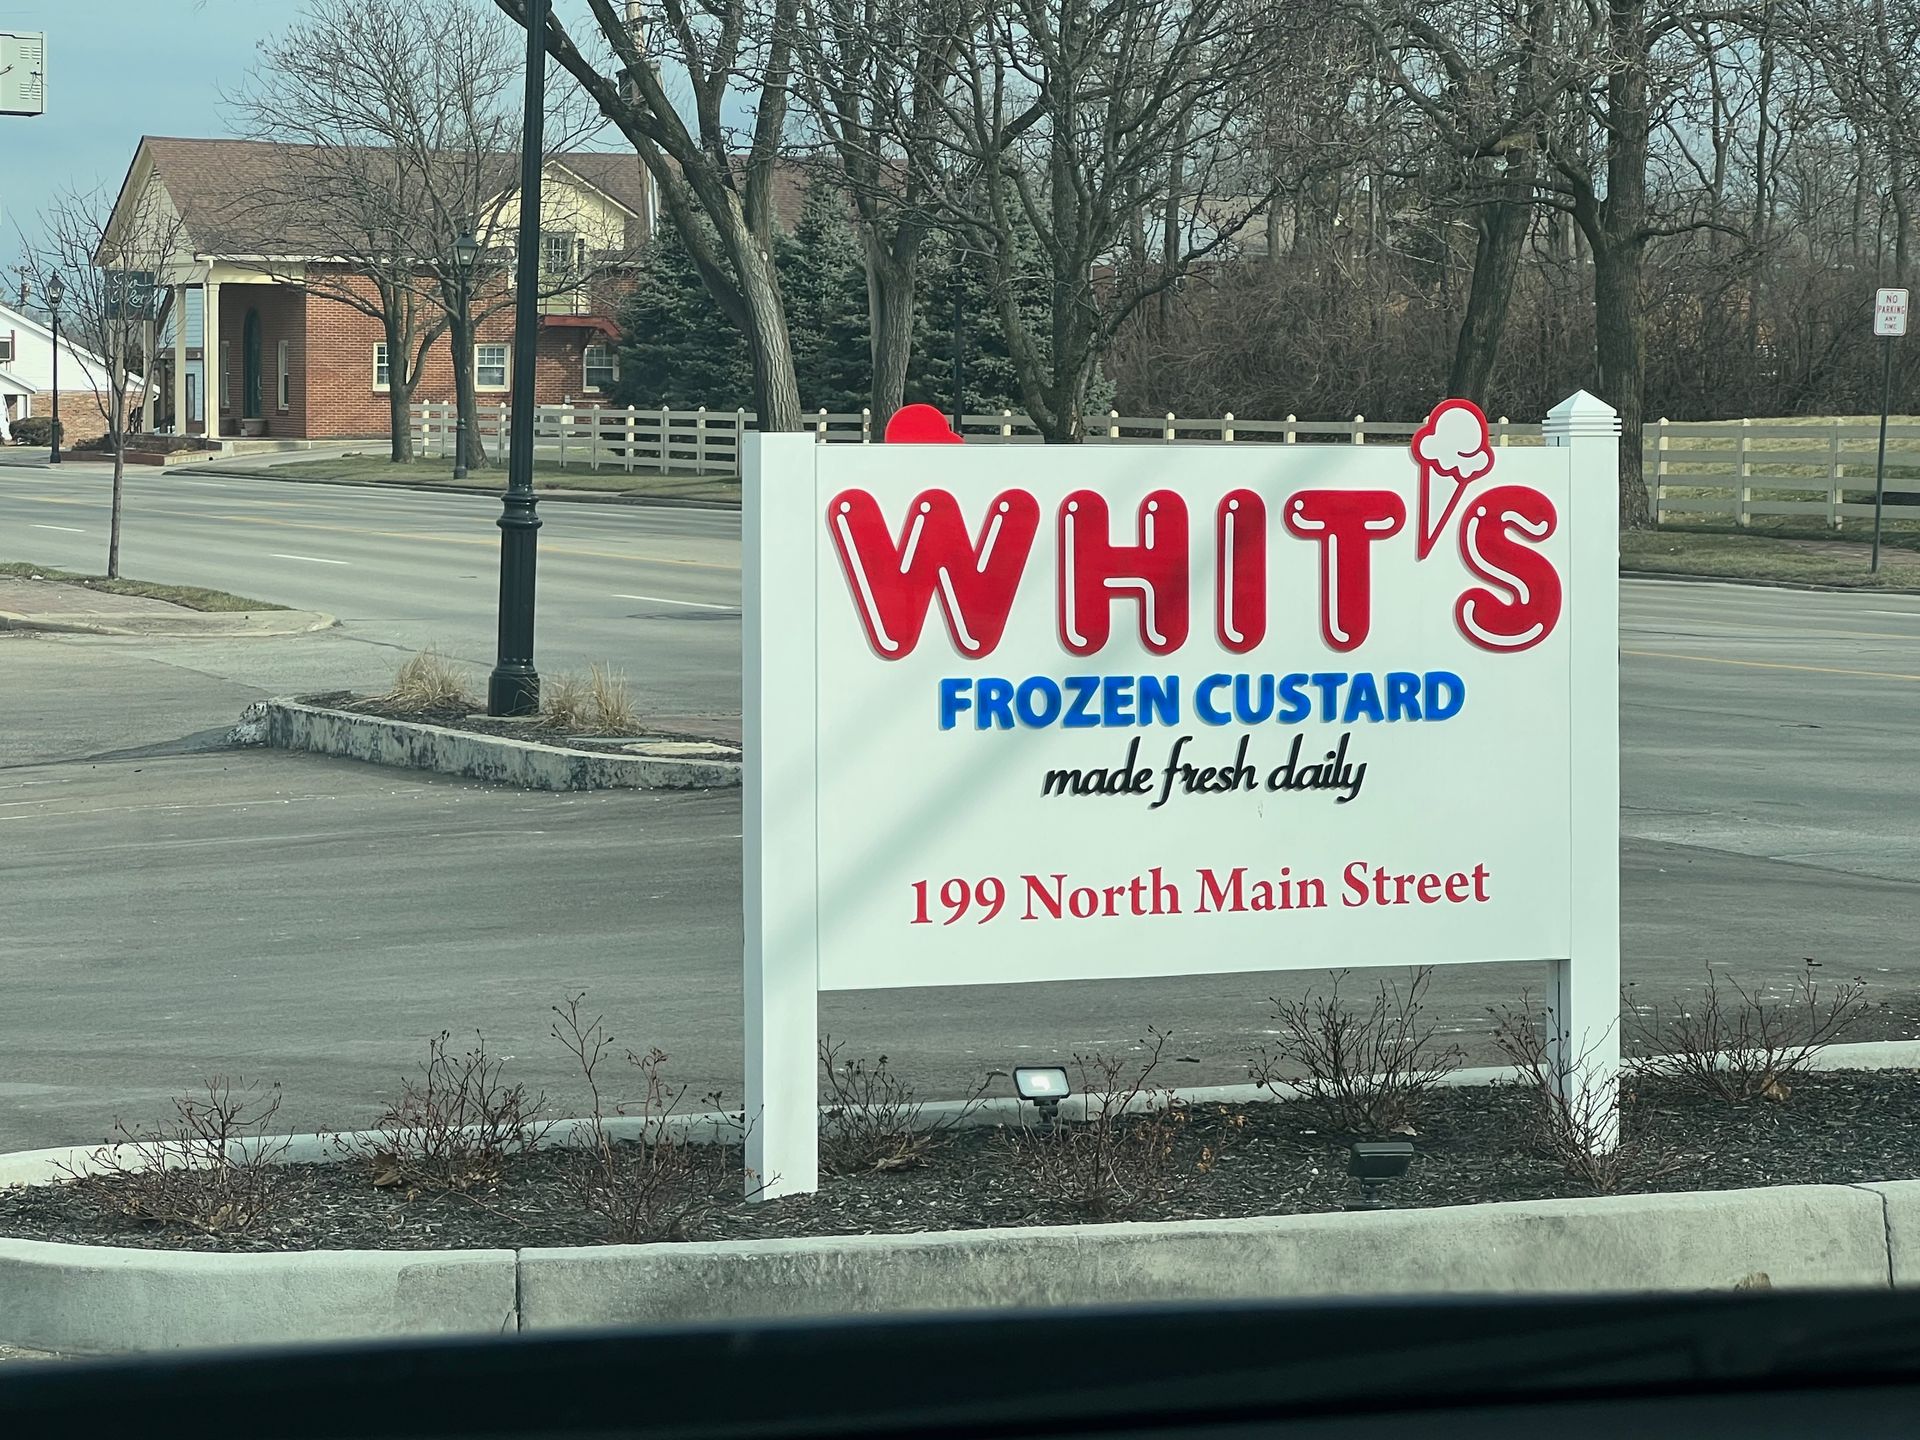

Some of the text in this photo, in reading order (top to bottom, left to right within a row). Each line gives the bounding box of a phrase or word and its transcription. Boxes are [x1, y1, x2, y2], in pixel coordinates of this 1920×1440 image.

[1877, 305, 1905, 314] PARKING
[1886, 294, 1898, 304] NO
[828, 398, 1563, 660] WHIT'S
[939, 670, 1466, 730] FROZEN CUSTARD
[1042, 732, 1367, 809] made fresh daily
[910, 862, 1490, 925] 199 North Main Street
